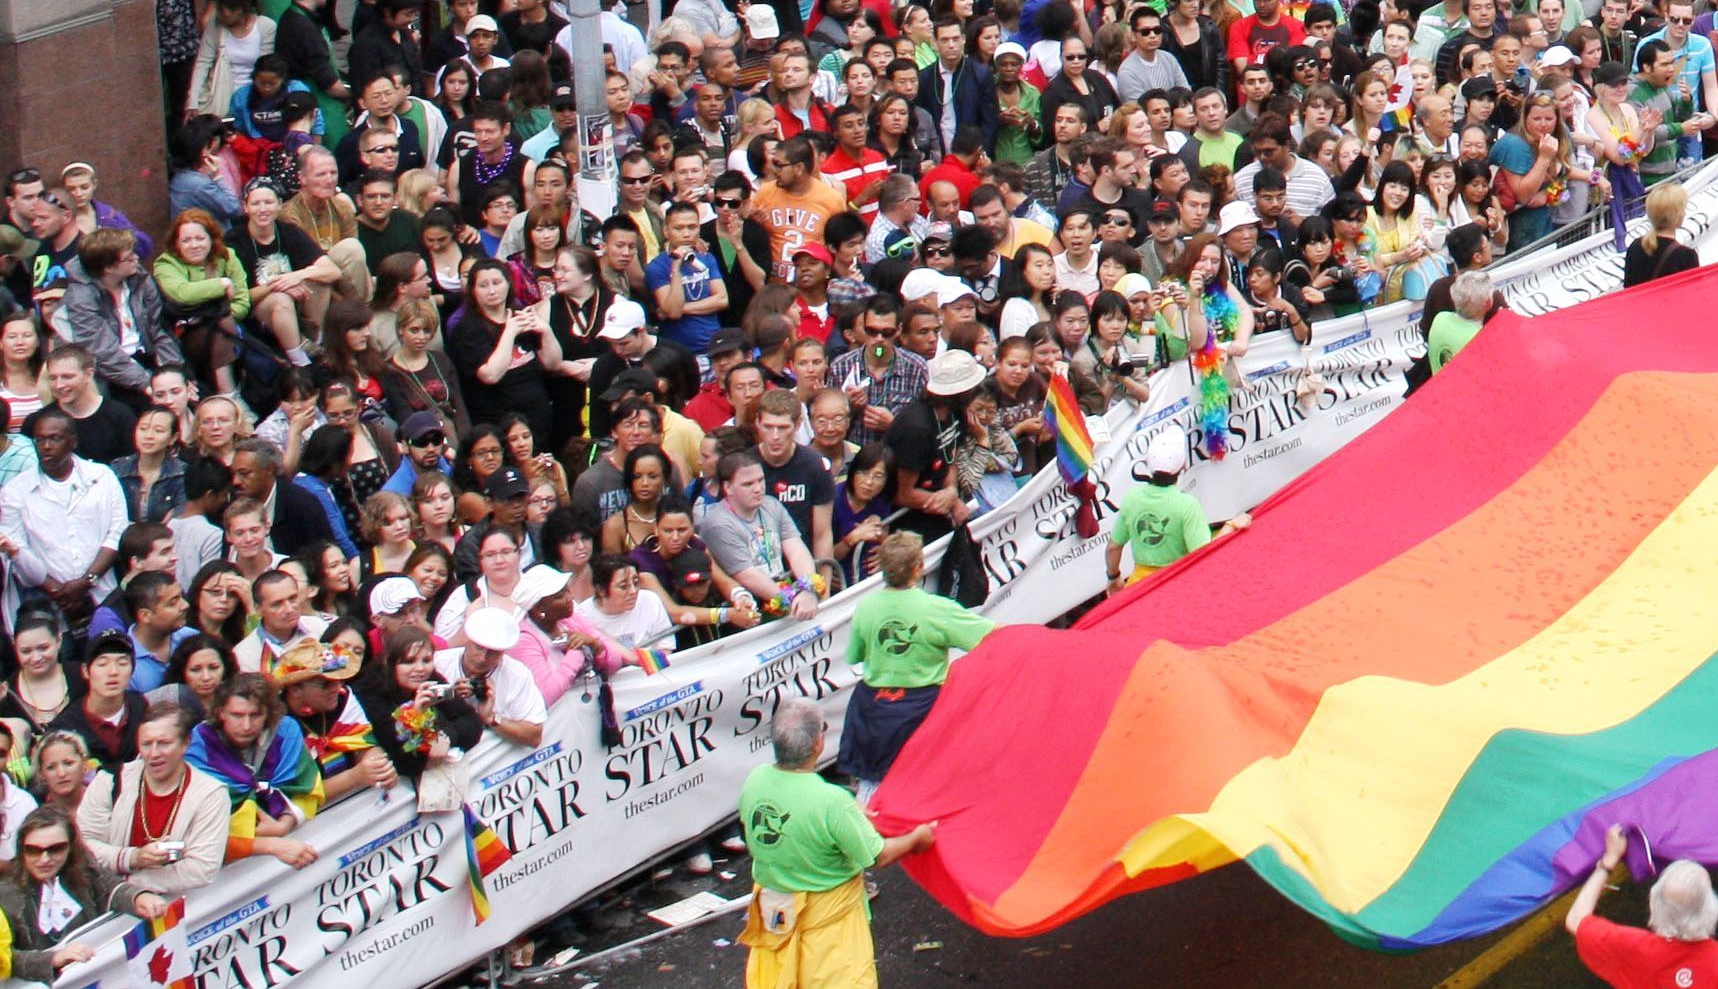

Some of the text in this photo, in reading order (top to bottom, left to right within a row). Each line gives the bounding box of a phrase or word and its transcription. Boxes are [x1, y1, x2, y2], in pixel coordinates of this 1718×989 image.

[771, 207, 819, 232] GIVE
[781, 229, 804, 262] 2
[1227, 389, 1307, 452] STAR
[1335, 395, 1391, 426] thestar.com
[1243, 437, 1302, 468] thestar.com
[1050, 530, 1112, 570] thestar.com
[742, 631, 833, 696] TORONTO
[608, 689, 724, 755] ORONTO
[634, 701, 658, 717] VOICE
[677, 685, 697, 700] GTA
[734, 657, 840, 737] STAR
[535, 746, 555, 761] GTA
[605, 716, 717, 803] STAR
[489, 780, 588, 855] TAR
[624, 772, 705, 819] thestar.com
[313, 821, 444, 907] TORONTO
[493, 840, 574, 892] thestar.com
[239, 903, 262, 919] GTA
[317, 854, 455, 956] STAR
[192, 903, 291, 974] RONTO
[195, 935, 303, 989] TAR
[340, 915, 435, 971] thestar.com
